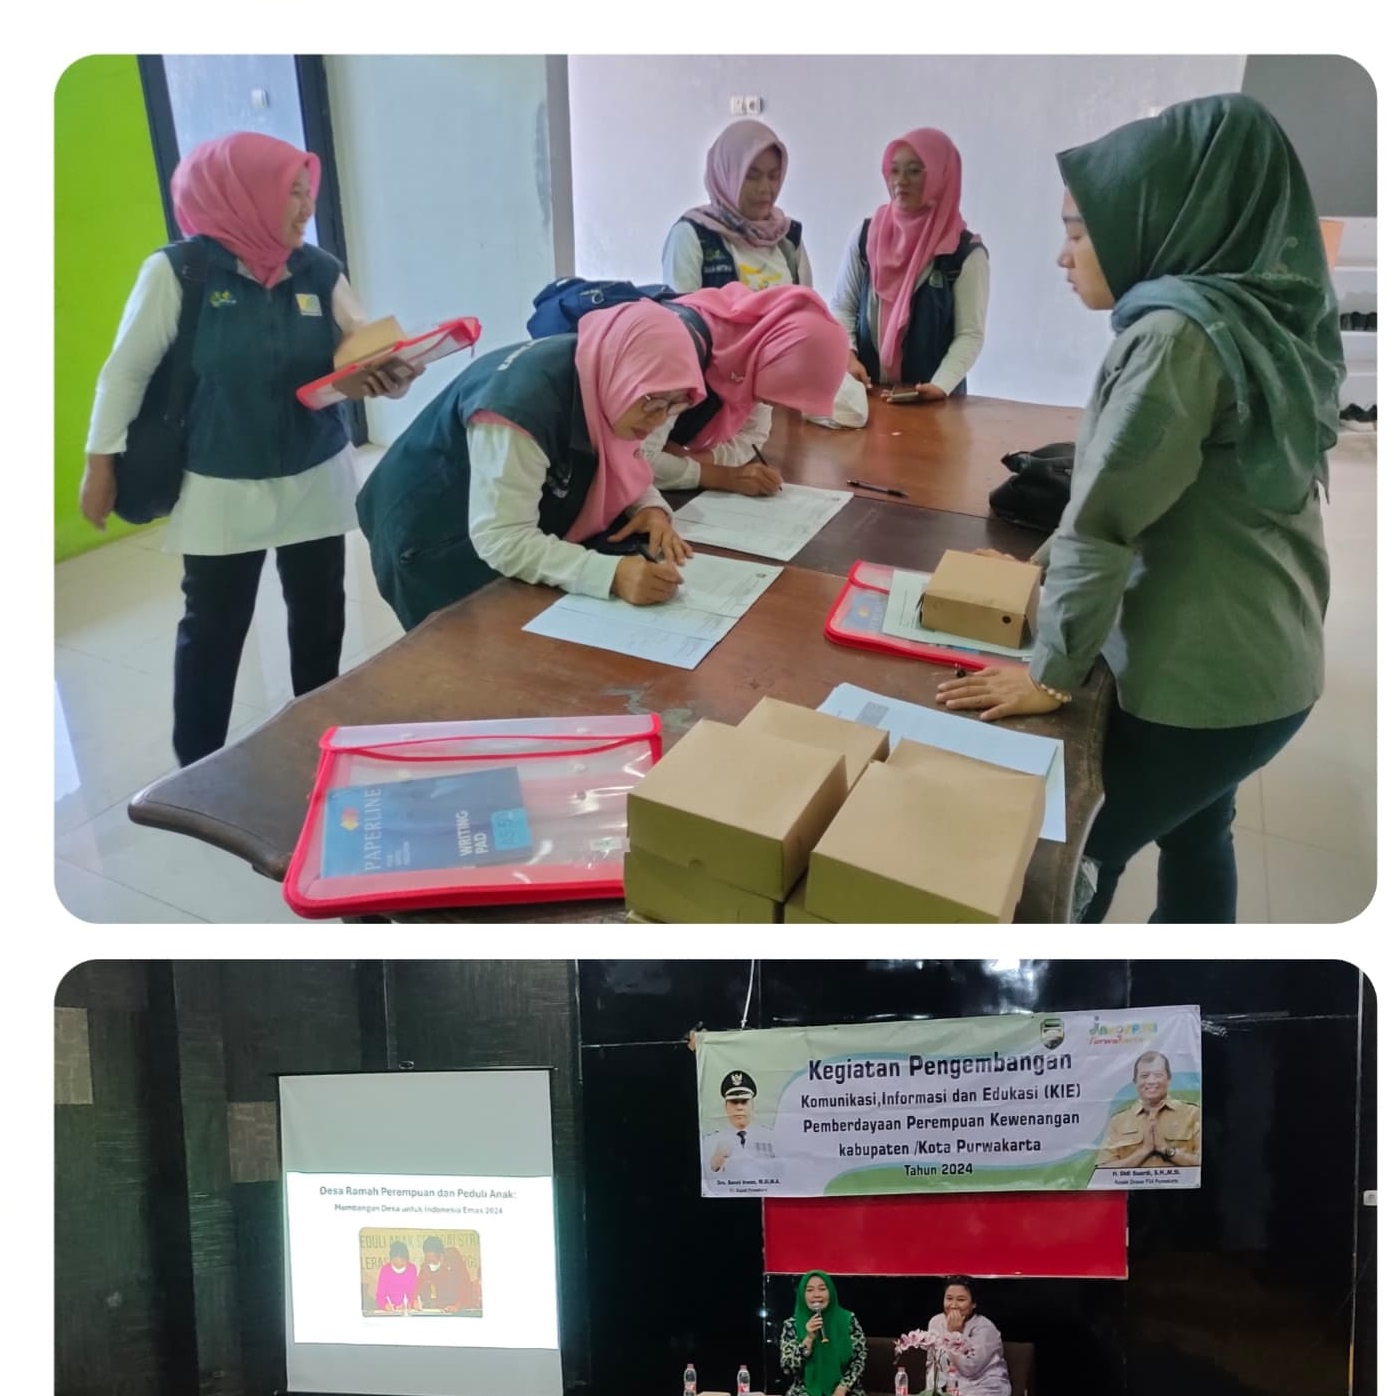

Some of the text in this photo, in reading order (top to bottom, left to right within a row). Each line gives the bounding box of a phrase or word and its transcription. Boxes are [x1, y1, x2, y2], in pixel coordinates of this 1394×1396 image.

[364, 788, 382, 871] PAPERLINE
[456, 810, 473, 857] WRITING
[473, 833, 489, 855] PAD
[808, 1052, 1072, 1084] Kegiatan Pengembangan
[801, 1083, 1081, 1110] Komunikasi,Informasi dan Edukasi (KIE)
[803, 1111, 1080, 1137] Pemberdayaan Perempuan Kewenangan
[839, 1137, 1041, 1160] kabupaten /Kota Purwakarta
[904, 1162, 973, 1176] Tahun 2024
[319, 1186, 344, 1196] Desa
[345, 1186, 379, 1196] Ramah
[381, 1187, 436, 1198] Perempuan
[437, 1188, 455, 1197] dan
[457, 1188, 487, 1198] Peduli
